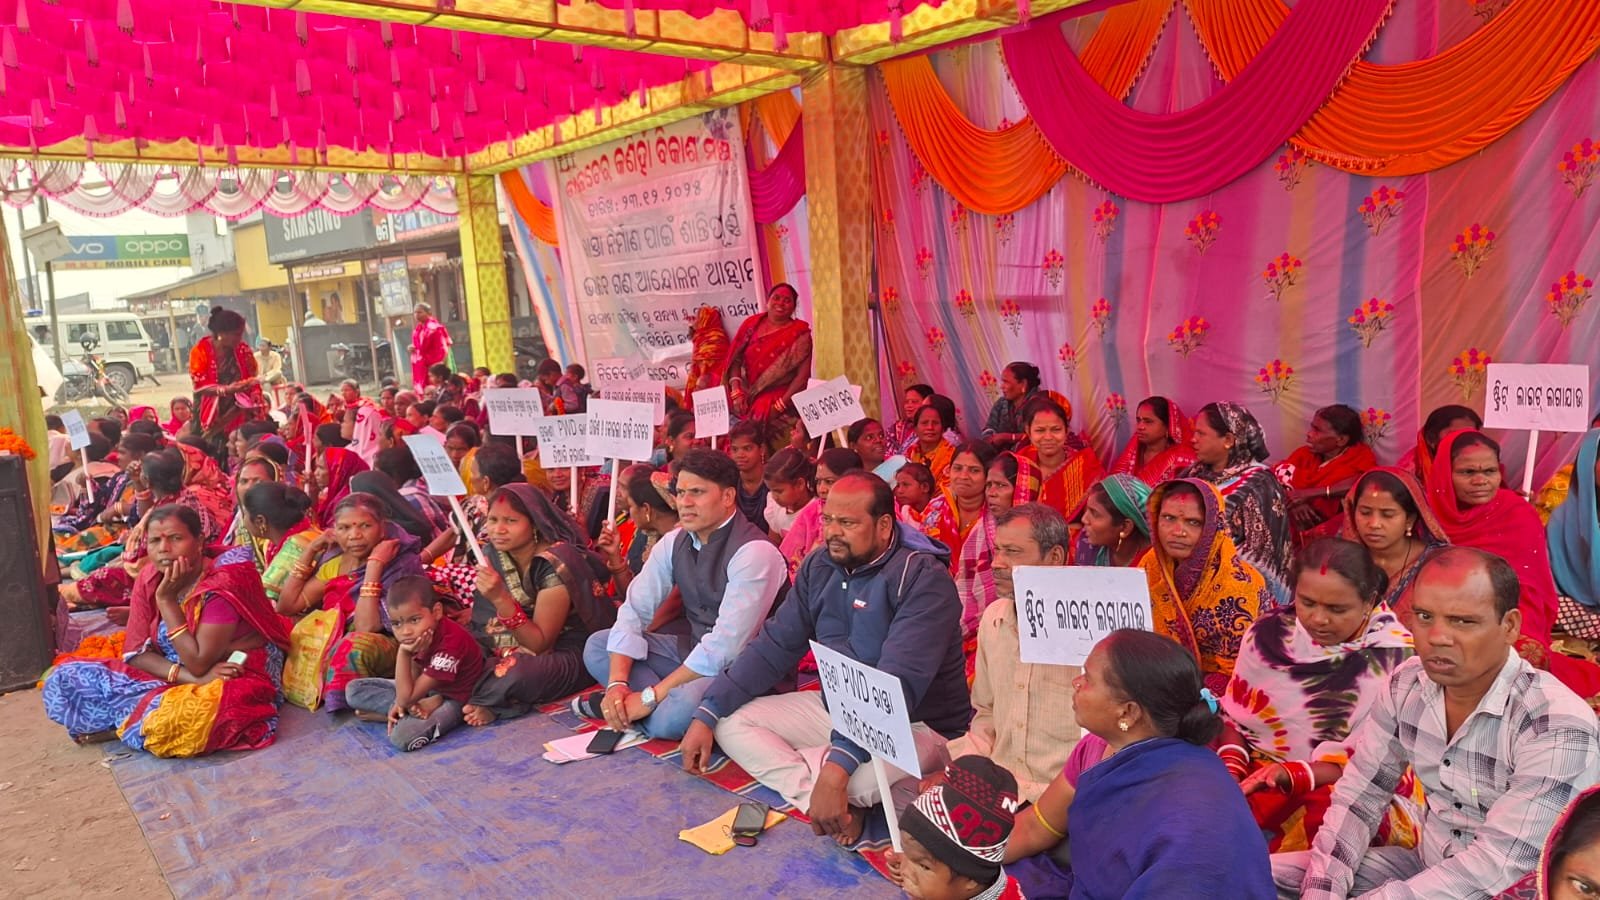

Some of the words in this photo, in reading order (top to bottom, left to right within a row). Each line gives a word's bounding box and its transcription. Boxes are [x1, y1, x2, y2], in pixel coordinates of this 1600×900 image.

[655, 127, 698, 165] ବିକାଶ
[125, 239, 183, 255] oppo
[105, 260, 149, 269] MOBILE
[153, 259, 182, 267] CARE
[557, 418, 577, 437] PWD
[841, 662, 870, 703] PWD
